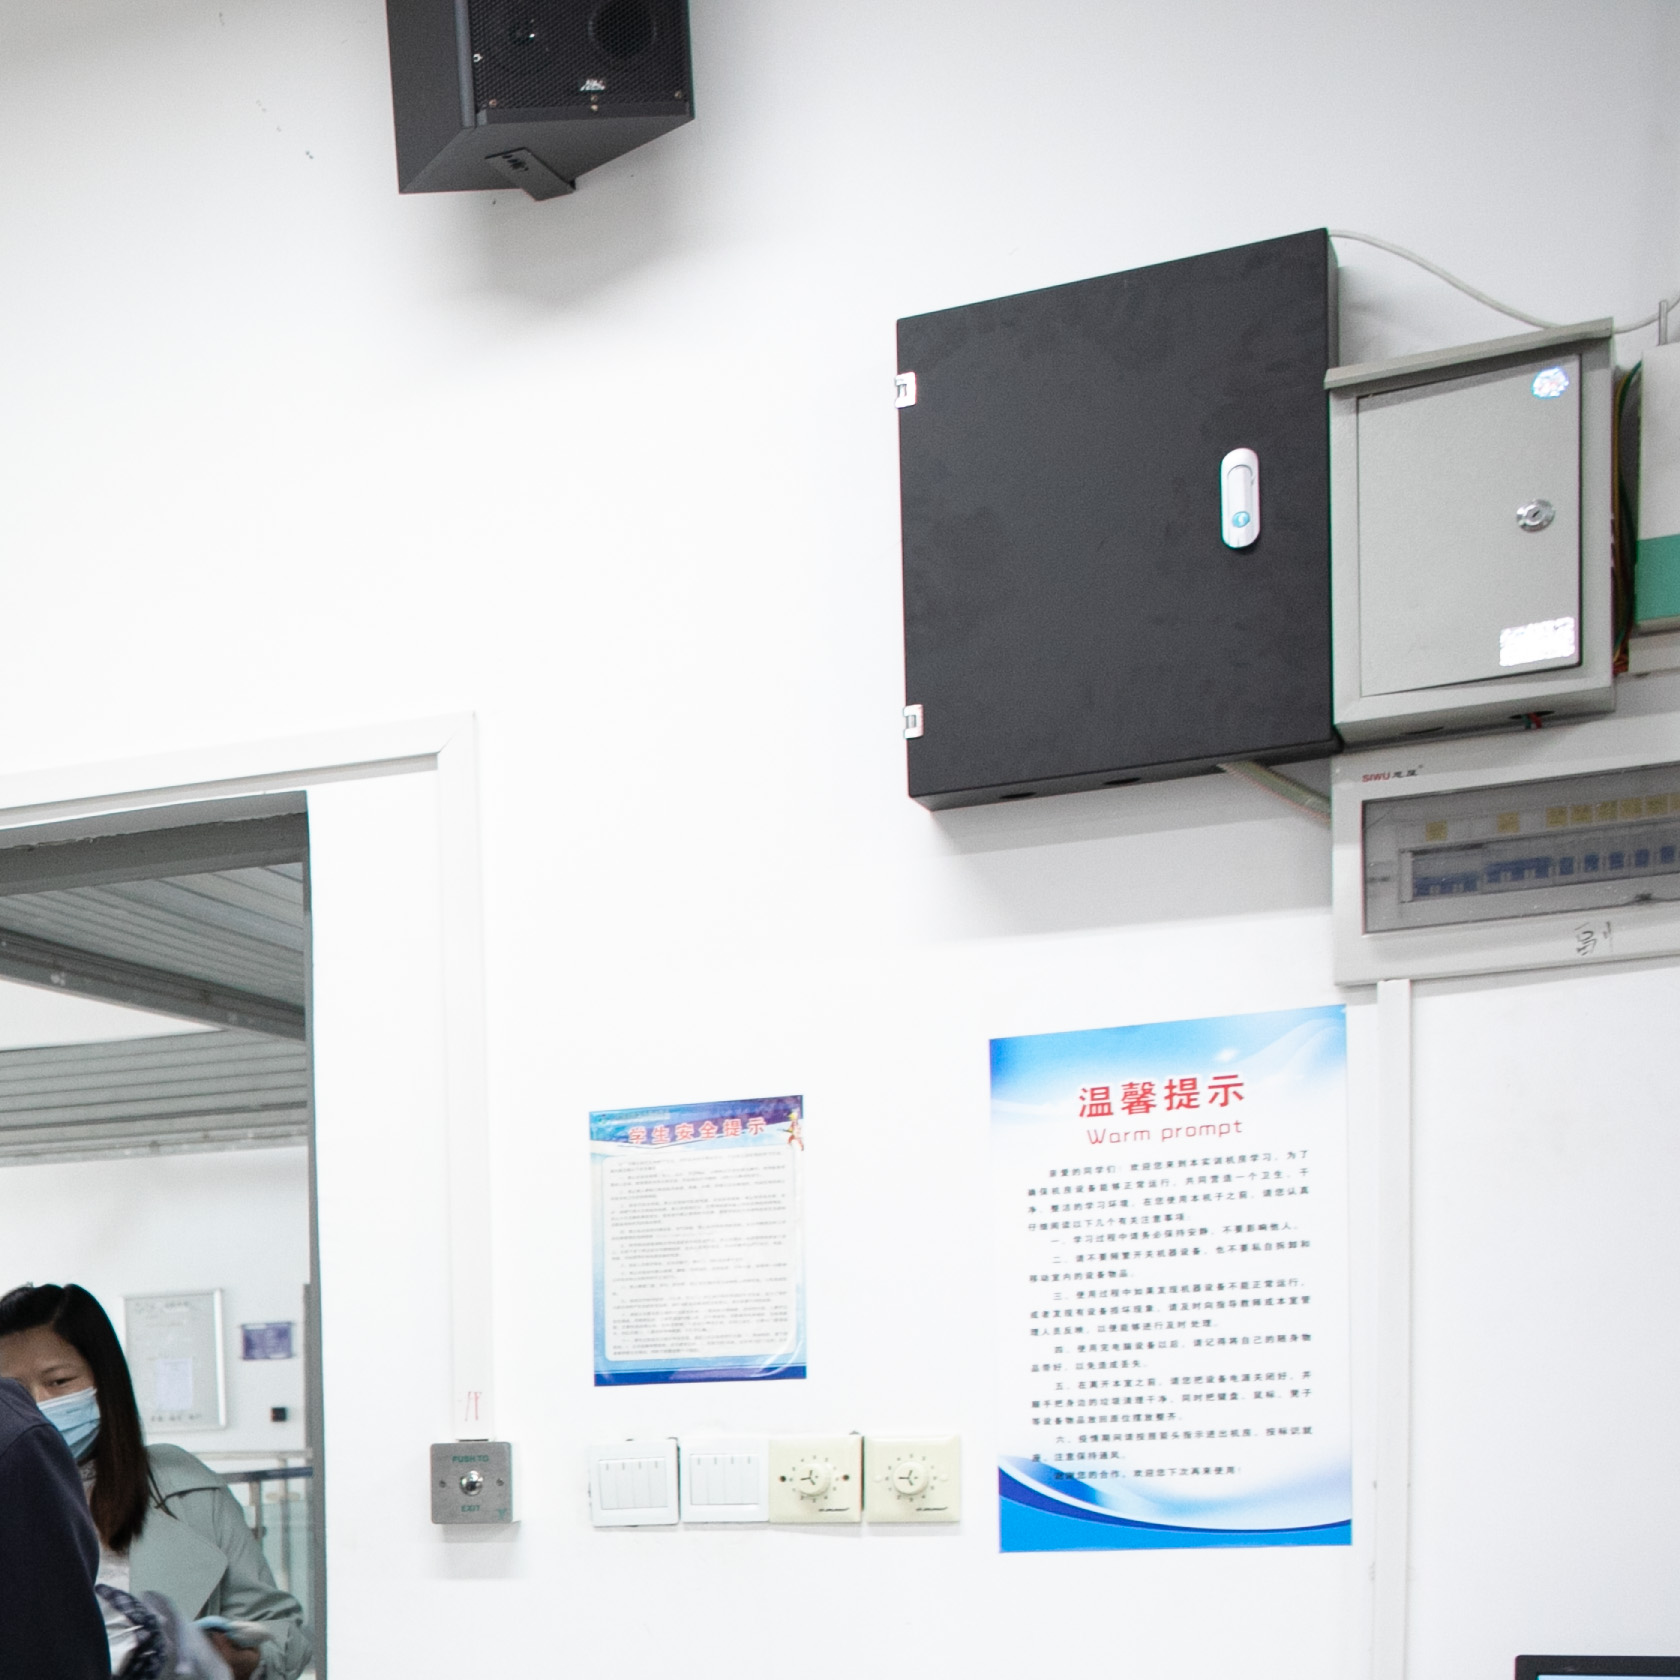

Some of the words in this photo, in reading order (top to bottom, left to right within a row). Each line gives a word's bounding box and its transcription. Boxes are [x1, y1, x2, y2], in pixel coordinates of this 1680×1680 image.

[1079, 1074, 1245, 1117] 温馨提示
[628, 1116, 767, 1146] 学生安全提示
[1086, 1128, 1151, 1145] Warm
[1161, 1120, 1243, 1142] prompt
[477, 1454, 489, 1462] TO
